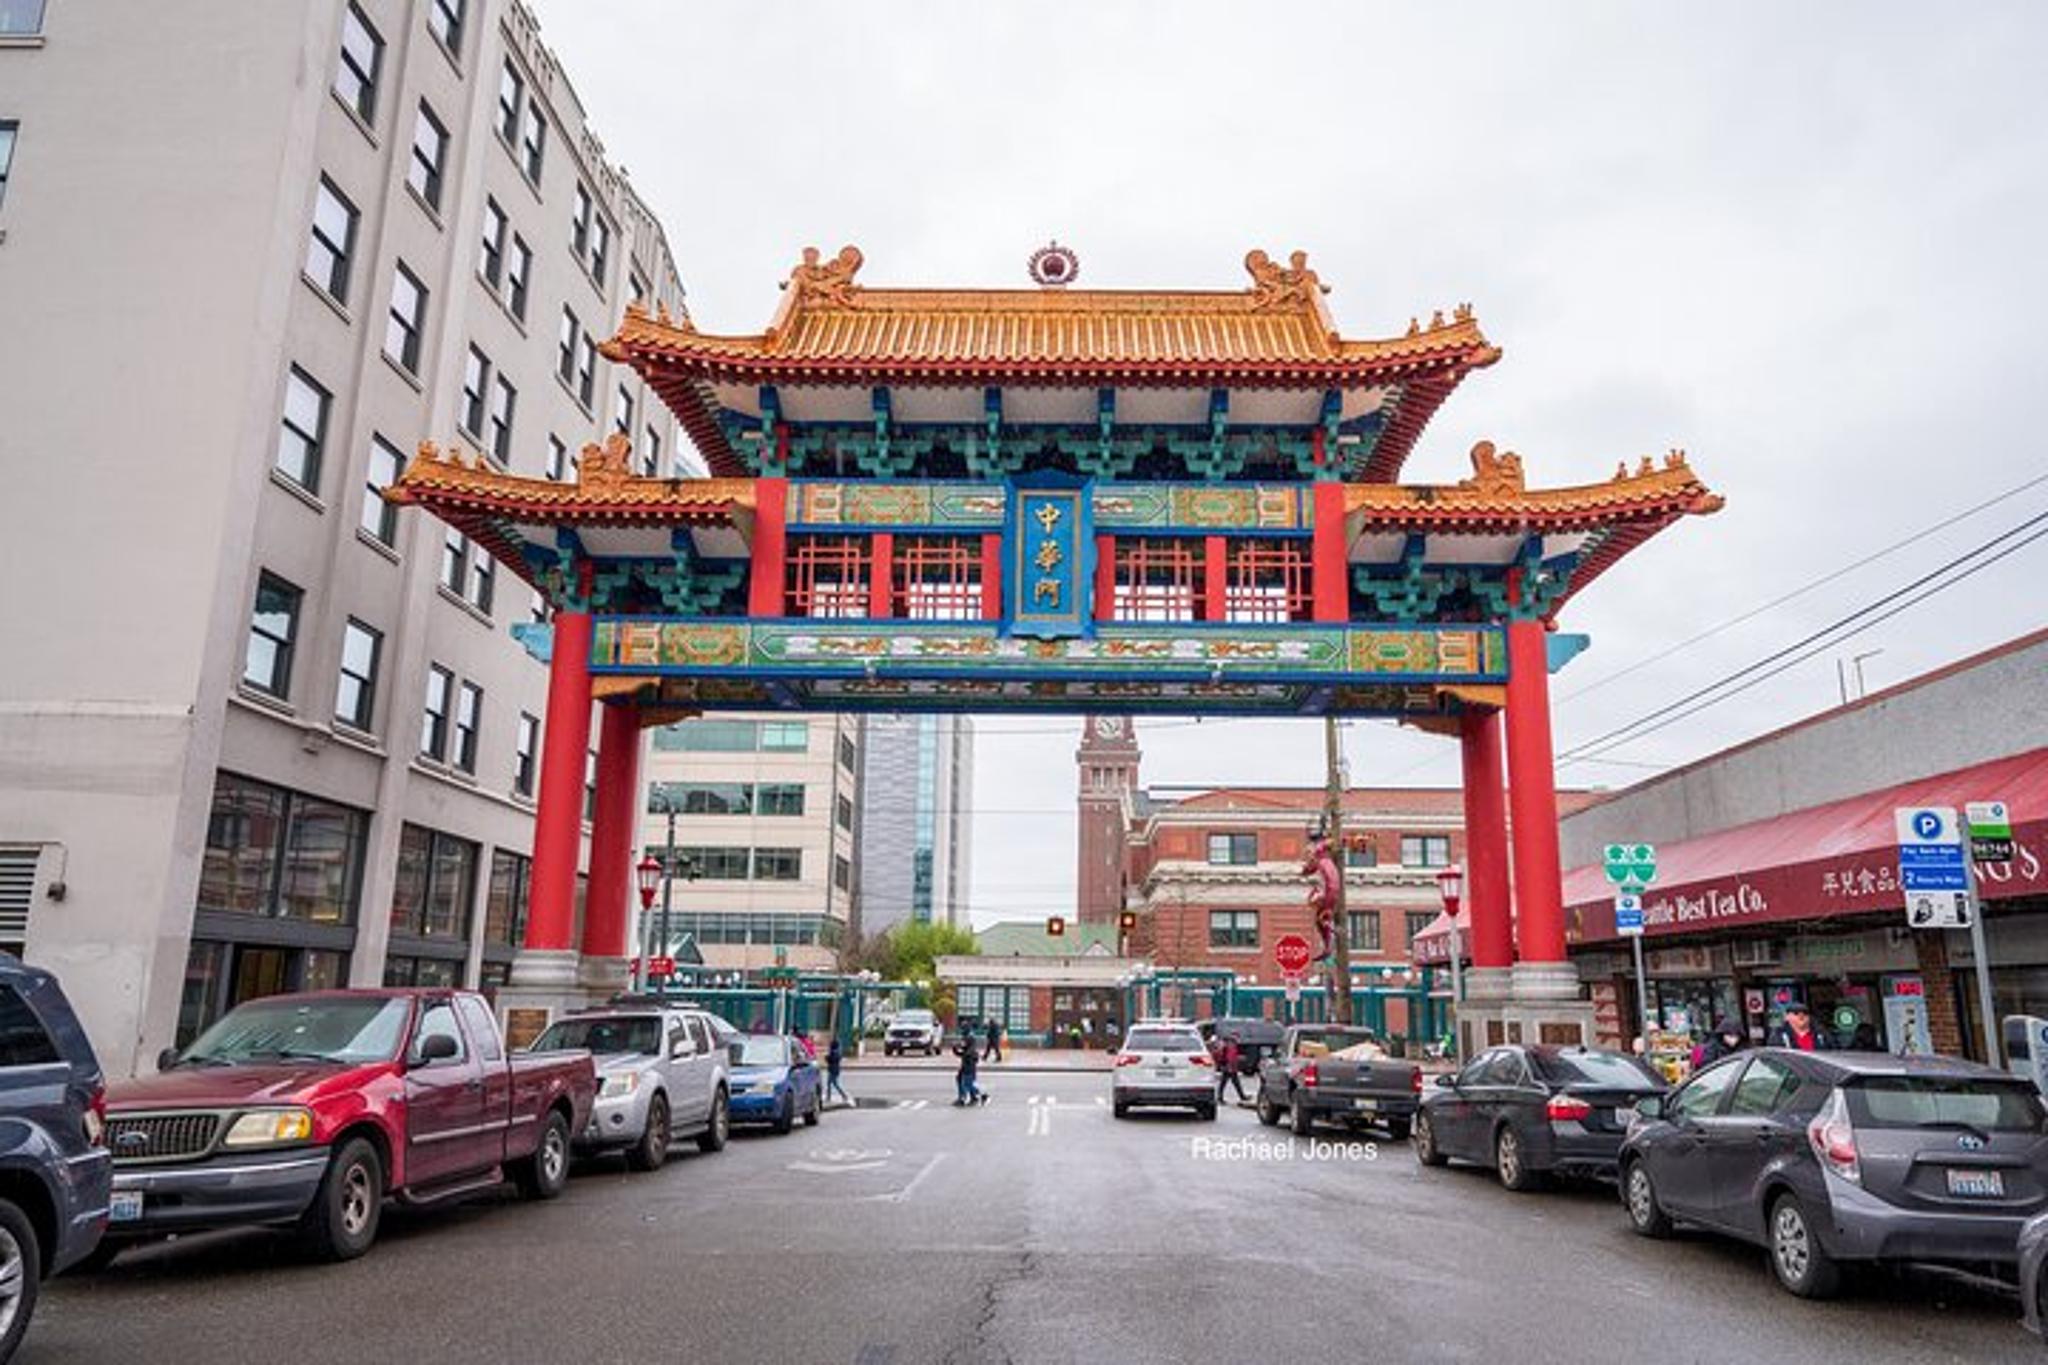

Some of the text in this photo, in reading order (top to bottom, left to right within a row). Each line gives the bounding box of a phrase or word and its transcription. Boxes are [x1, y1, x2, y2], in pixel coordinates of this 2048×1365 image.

[1035, 503, 1062, 607] 中華門
[1920, 817, 1936, 834] P
[1905, 871, 1915, 884] 2
[1642, 884, 1768, 925] eattle Best Tea Co.
[1278, 946, 1307, 961] STOP
